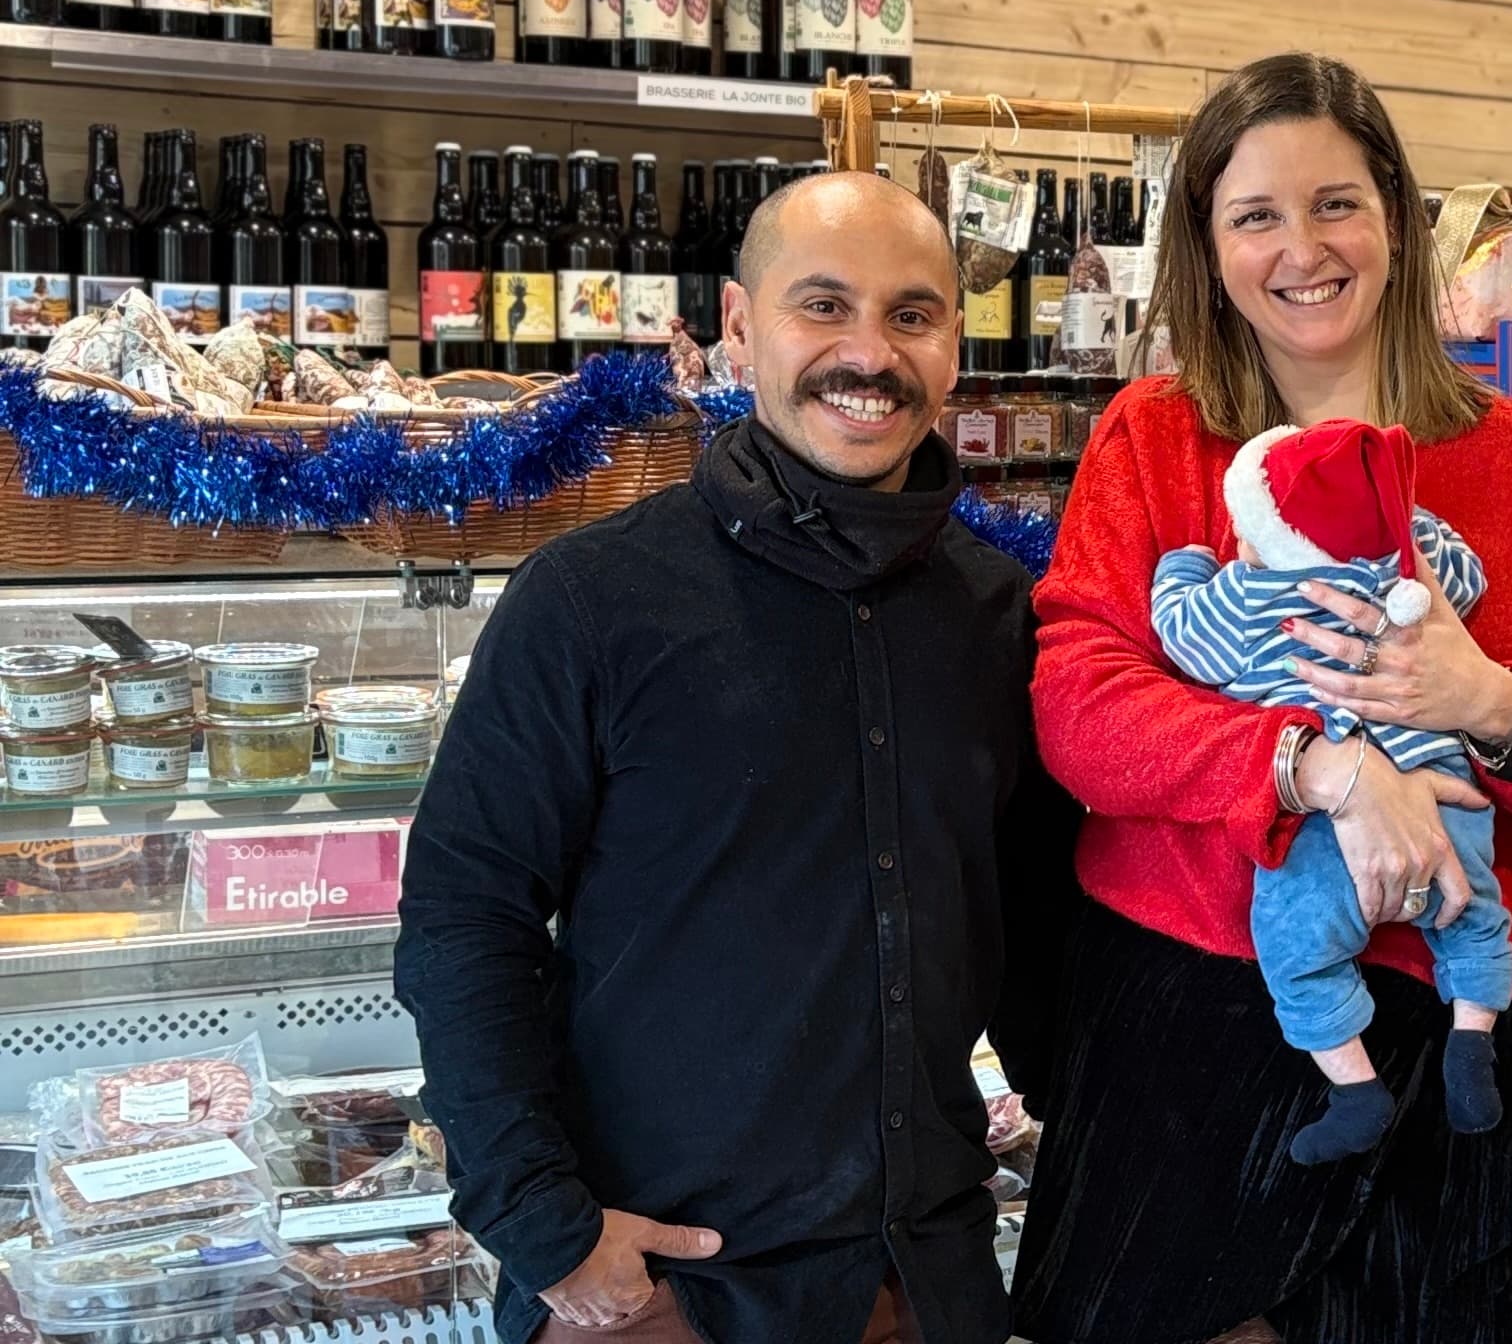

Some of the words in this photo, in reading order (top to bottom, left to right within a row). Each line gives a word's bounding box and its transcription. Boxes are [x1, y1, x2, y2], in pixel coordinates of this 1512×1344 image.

[645, 84, 716, 101] BRASSERIE
[722, 91, 738, 102] LA
[741, 91, 782, 106] JONTE
[785, 93, 807, 106] BIO
[226, 844, 266, 861] 300
[226, 876, 349, 911] Etirable
